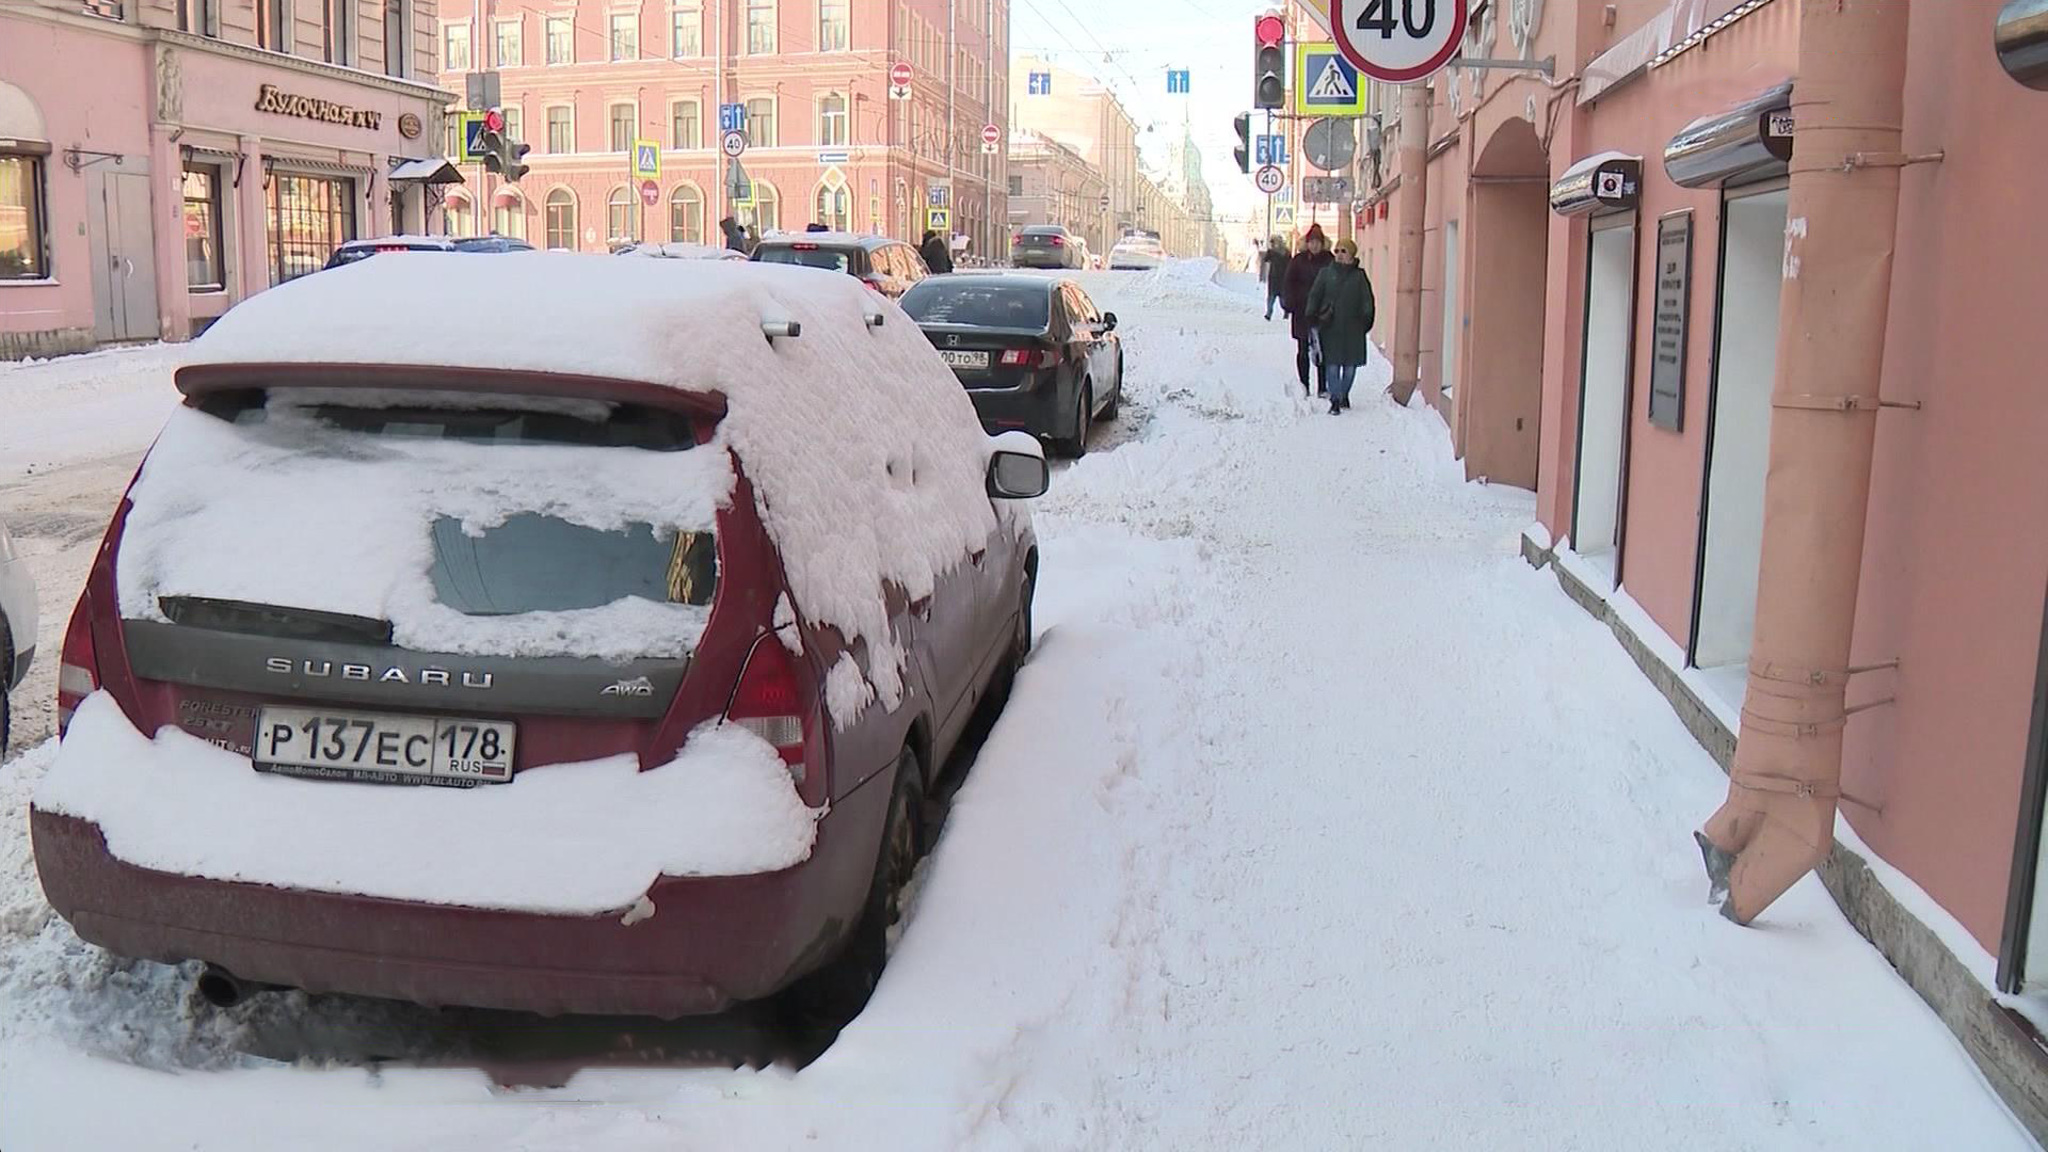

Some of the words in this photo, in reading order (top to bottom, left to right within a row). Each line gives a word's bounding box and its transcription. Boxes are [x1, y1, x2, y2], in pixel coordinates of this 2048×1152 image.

[1356, 0, 1435, 39] 40
[727, 138, 741, 149] 40
[1261, 173, 1278, 186] 40
[266, 657, 495, 689] SUBARU
[440, 725, 500, 761] 178
[450, 759, 481, 773] RUS
